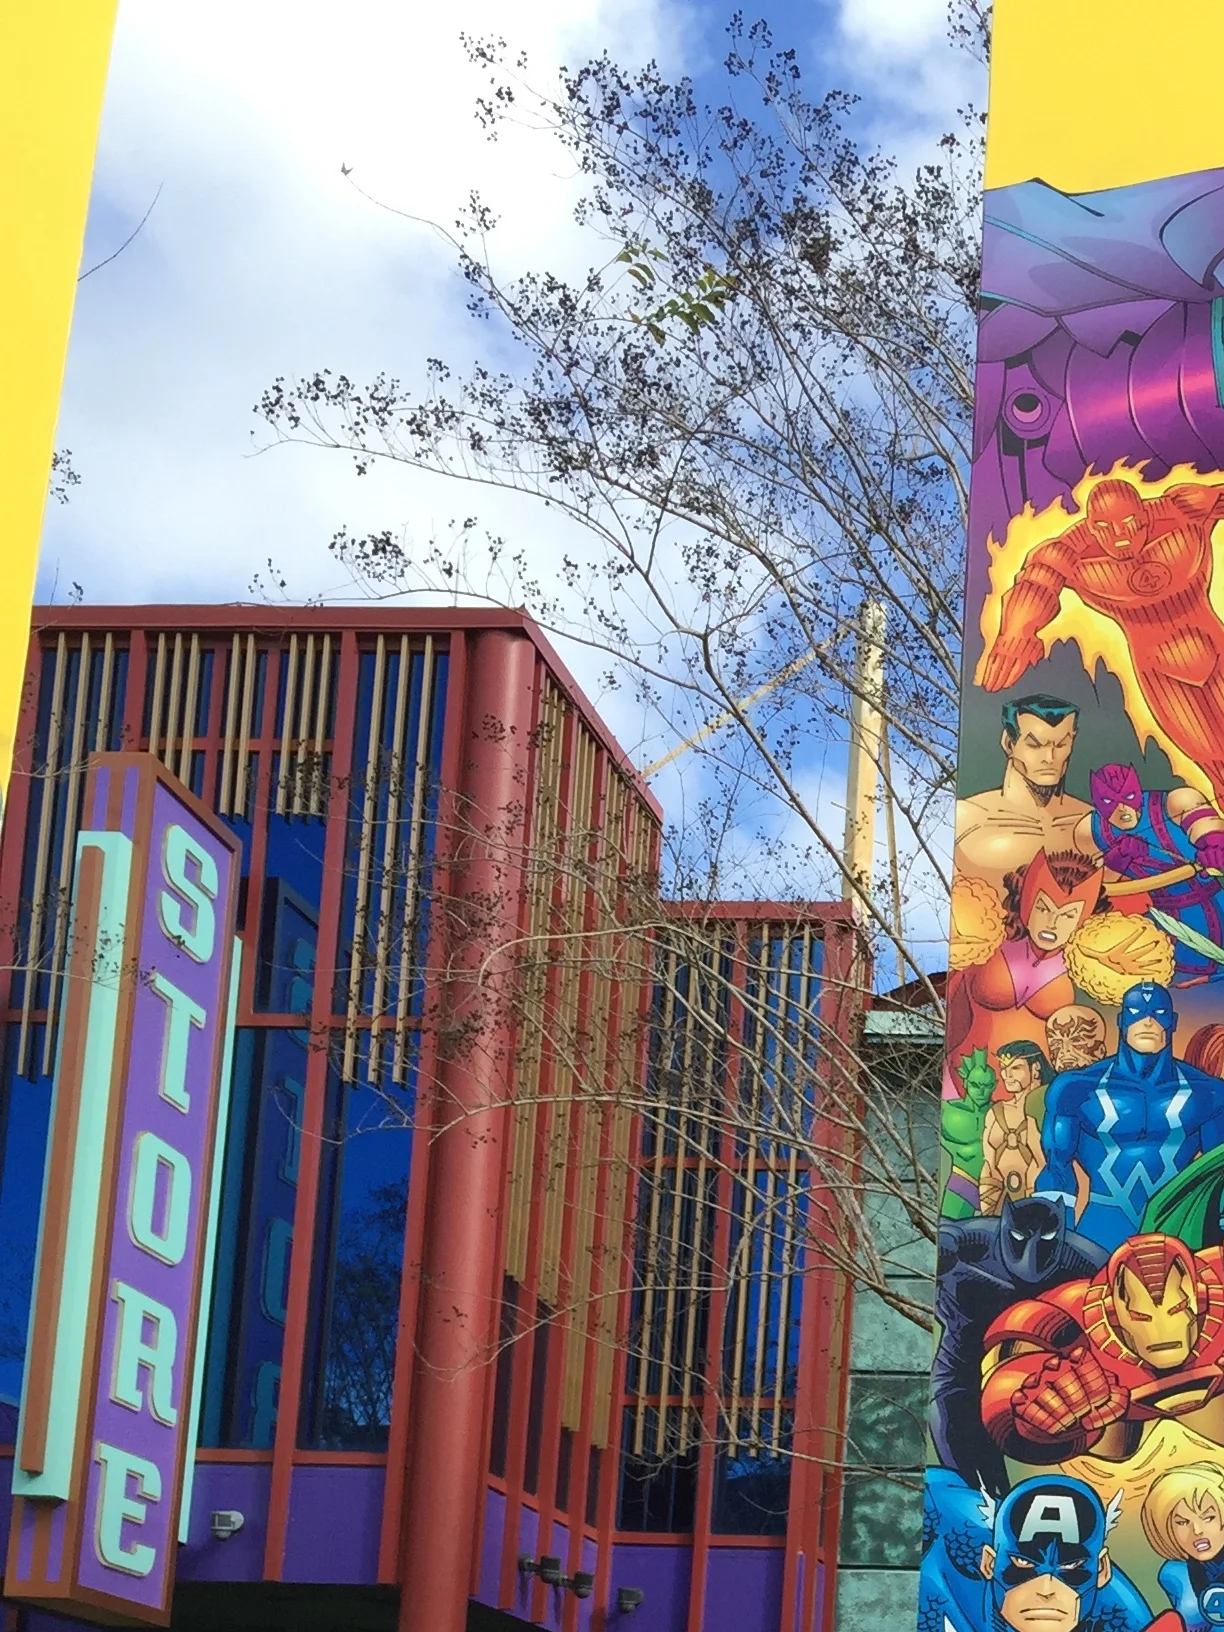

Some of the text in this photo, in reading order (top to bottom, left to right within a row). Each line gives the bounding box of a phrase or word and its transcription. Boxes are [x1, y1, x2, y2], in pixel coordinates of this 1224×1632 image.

[1139, 569, 1161, 589] 4
[93, 822, 219, 1580] STORE
[1018, 1494, 1080, 1544] A
